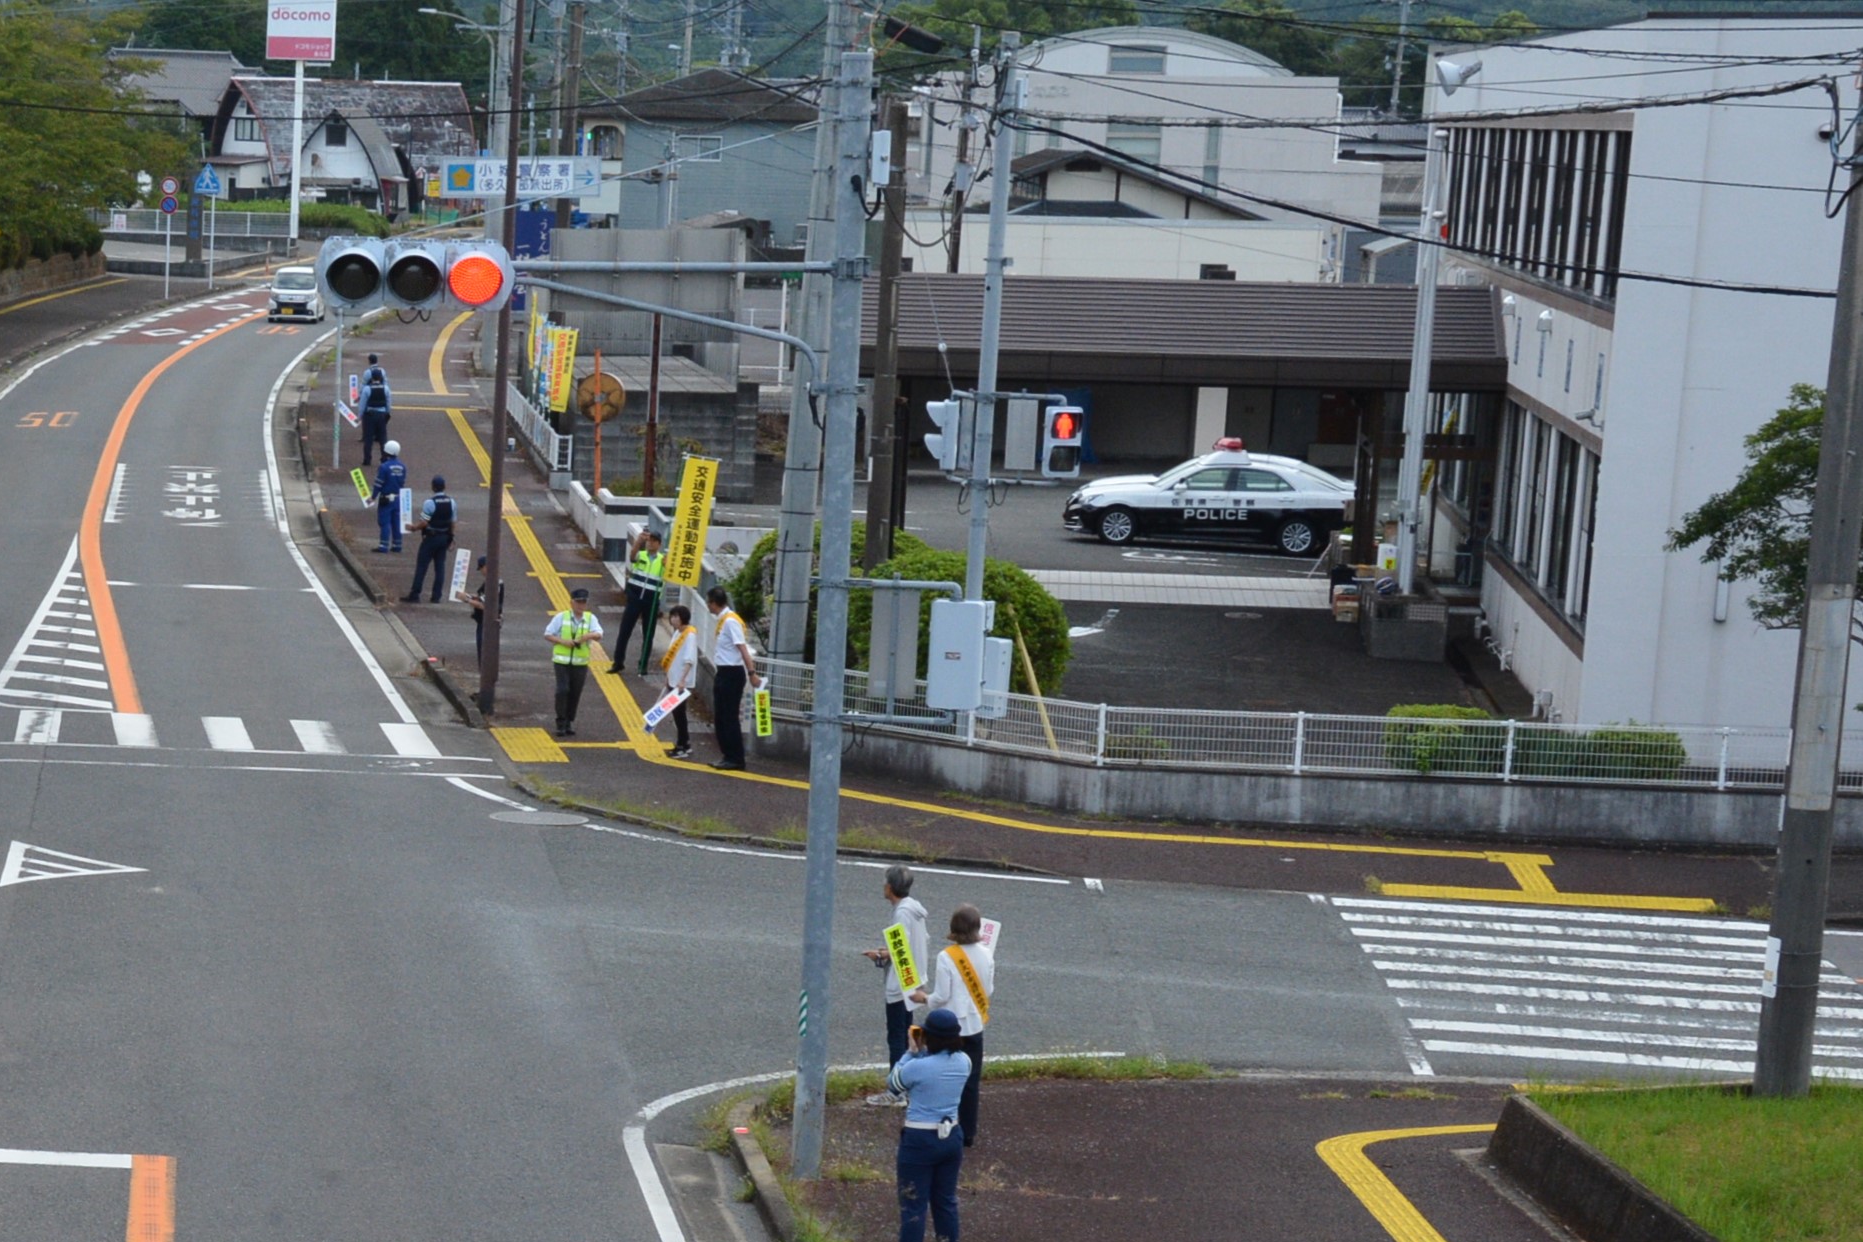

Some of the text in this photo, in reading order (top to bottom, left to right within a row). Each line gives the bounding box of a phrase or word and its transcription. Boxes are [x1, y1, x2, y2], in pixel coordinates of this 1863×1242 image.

[271, 7, 331, 21] docomo
[15, 411, 79, 428] 50
[1183, 508, 1248, 521] POLICE
[678, 465, 710, 582] 交通安全運動実施中
[889, 928, 916, 987] 事故多発注意
